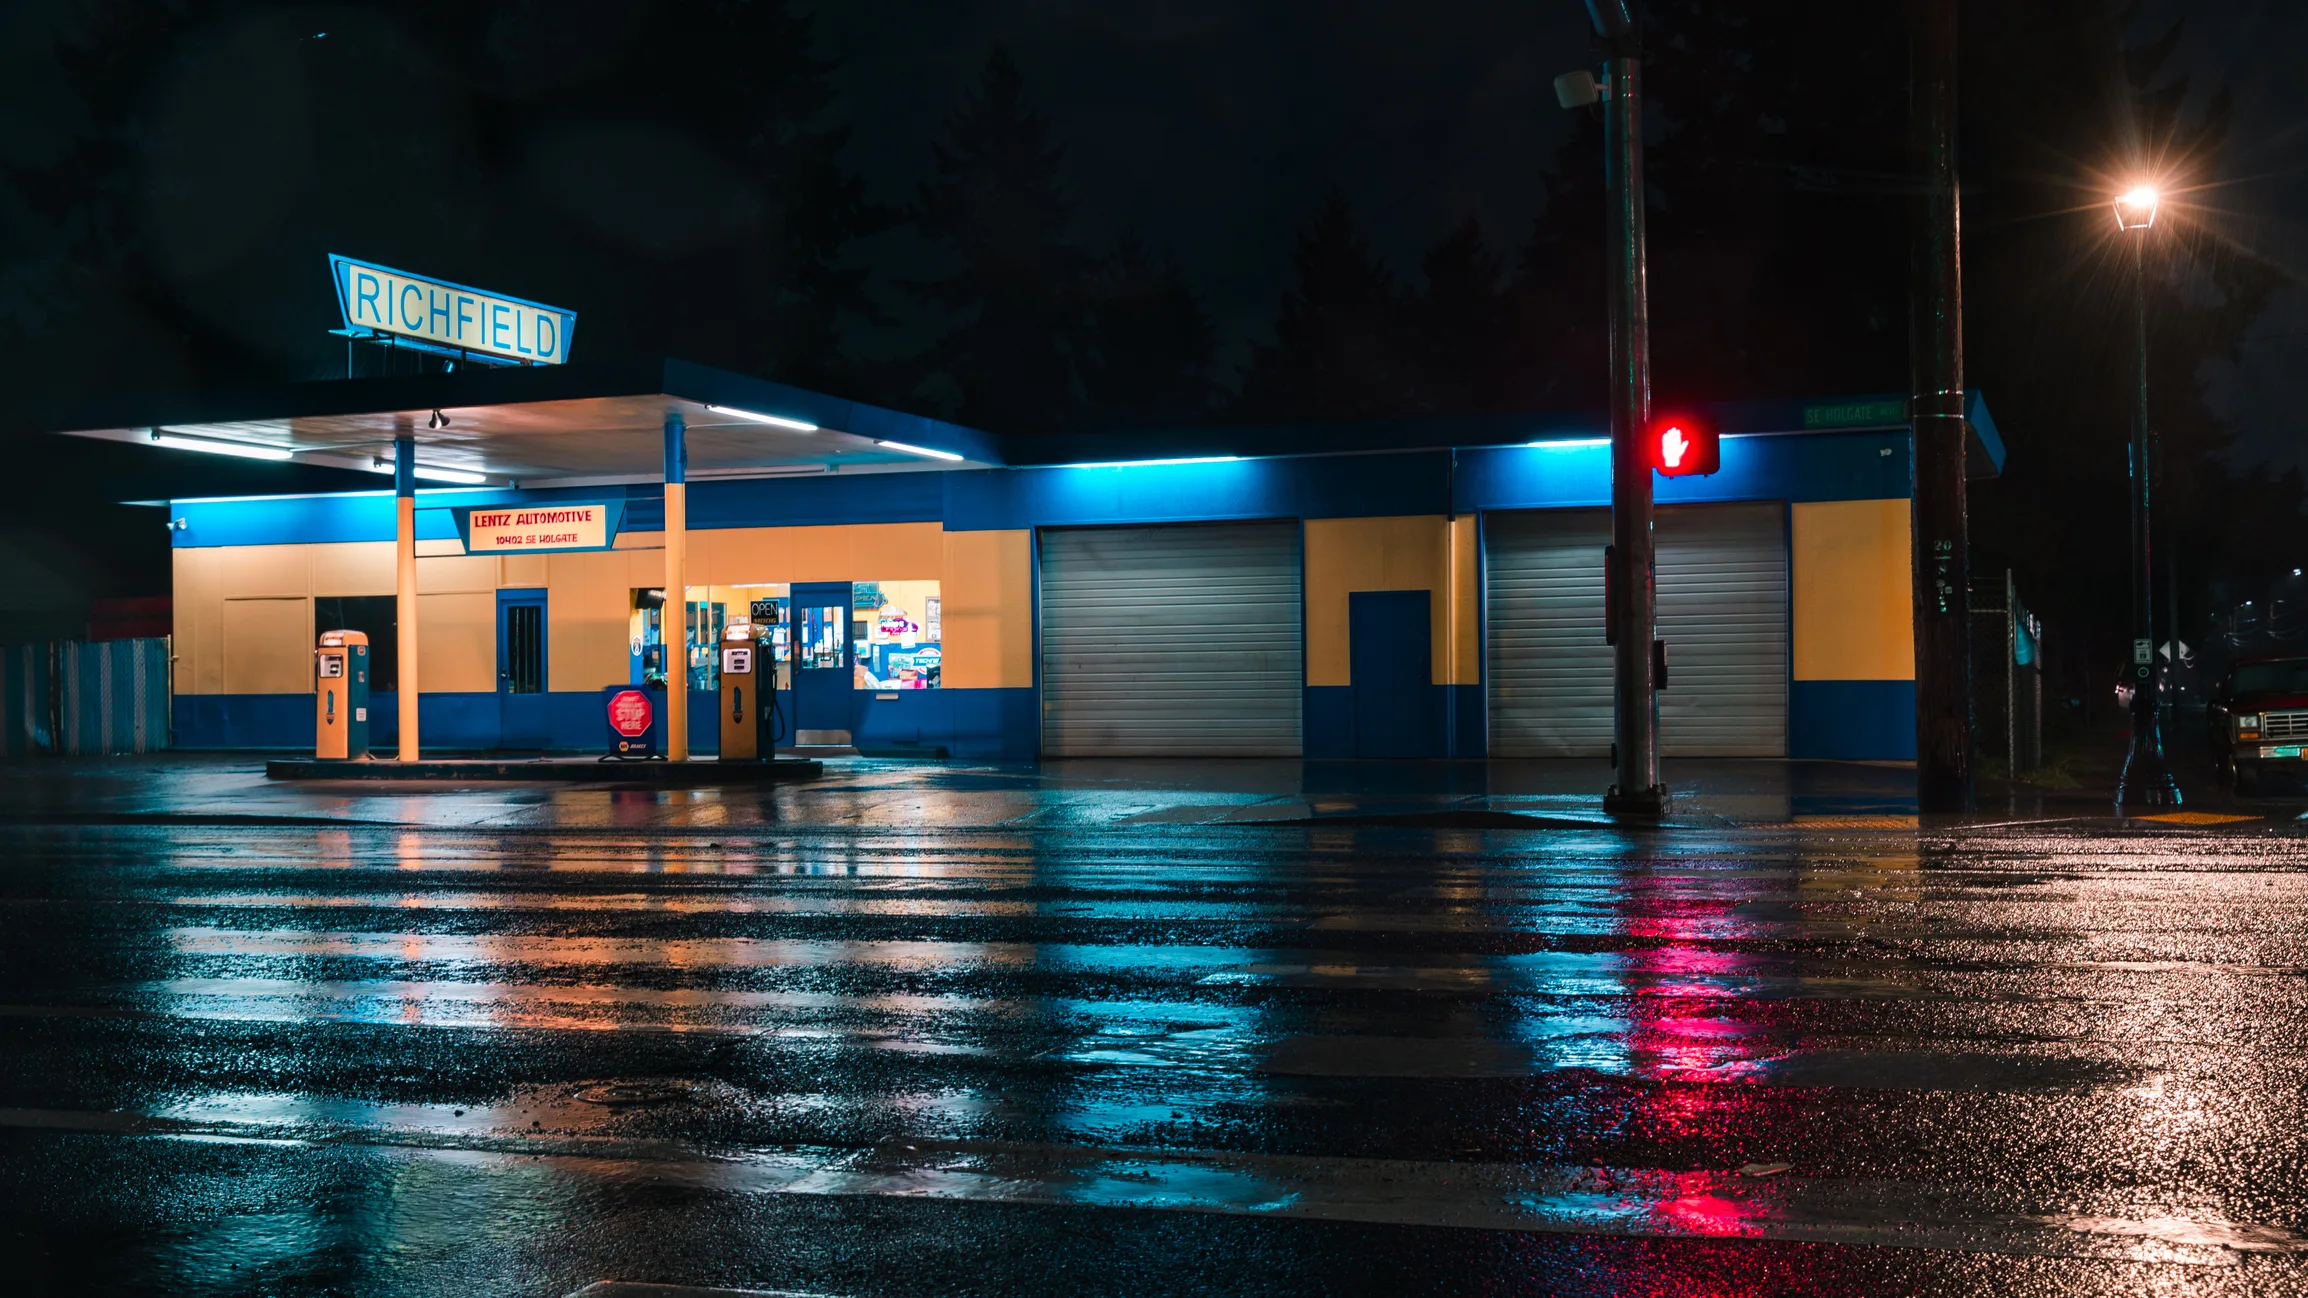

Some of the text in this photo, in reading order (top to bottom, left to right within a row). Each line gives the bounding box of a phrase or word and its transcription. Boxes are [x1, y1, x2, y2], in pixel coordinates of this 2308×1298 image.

[357, 272, 556, 358] RICHFIELD
[1806, 409, 1820, 424] SE
[1826, 405, 1873, 422] HOLGATE
[474, 510, 592, 528] LENTZ AUTOMOTIVE
[496, 533, 578, 545] 10402 SE HOLGATE
[751, 602, 778, 616] OPEN
